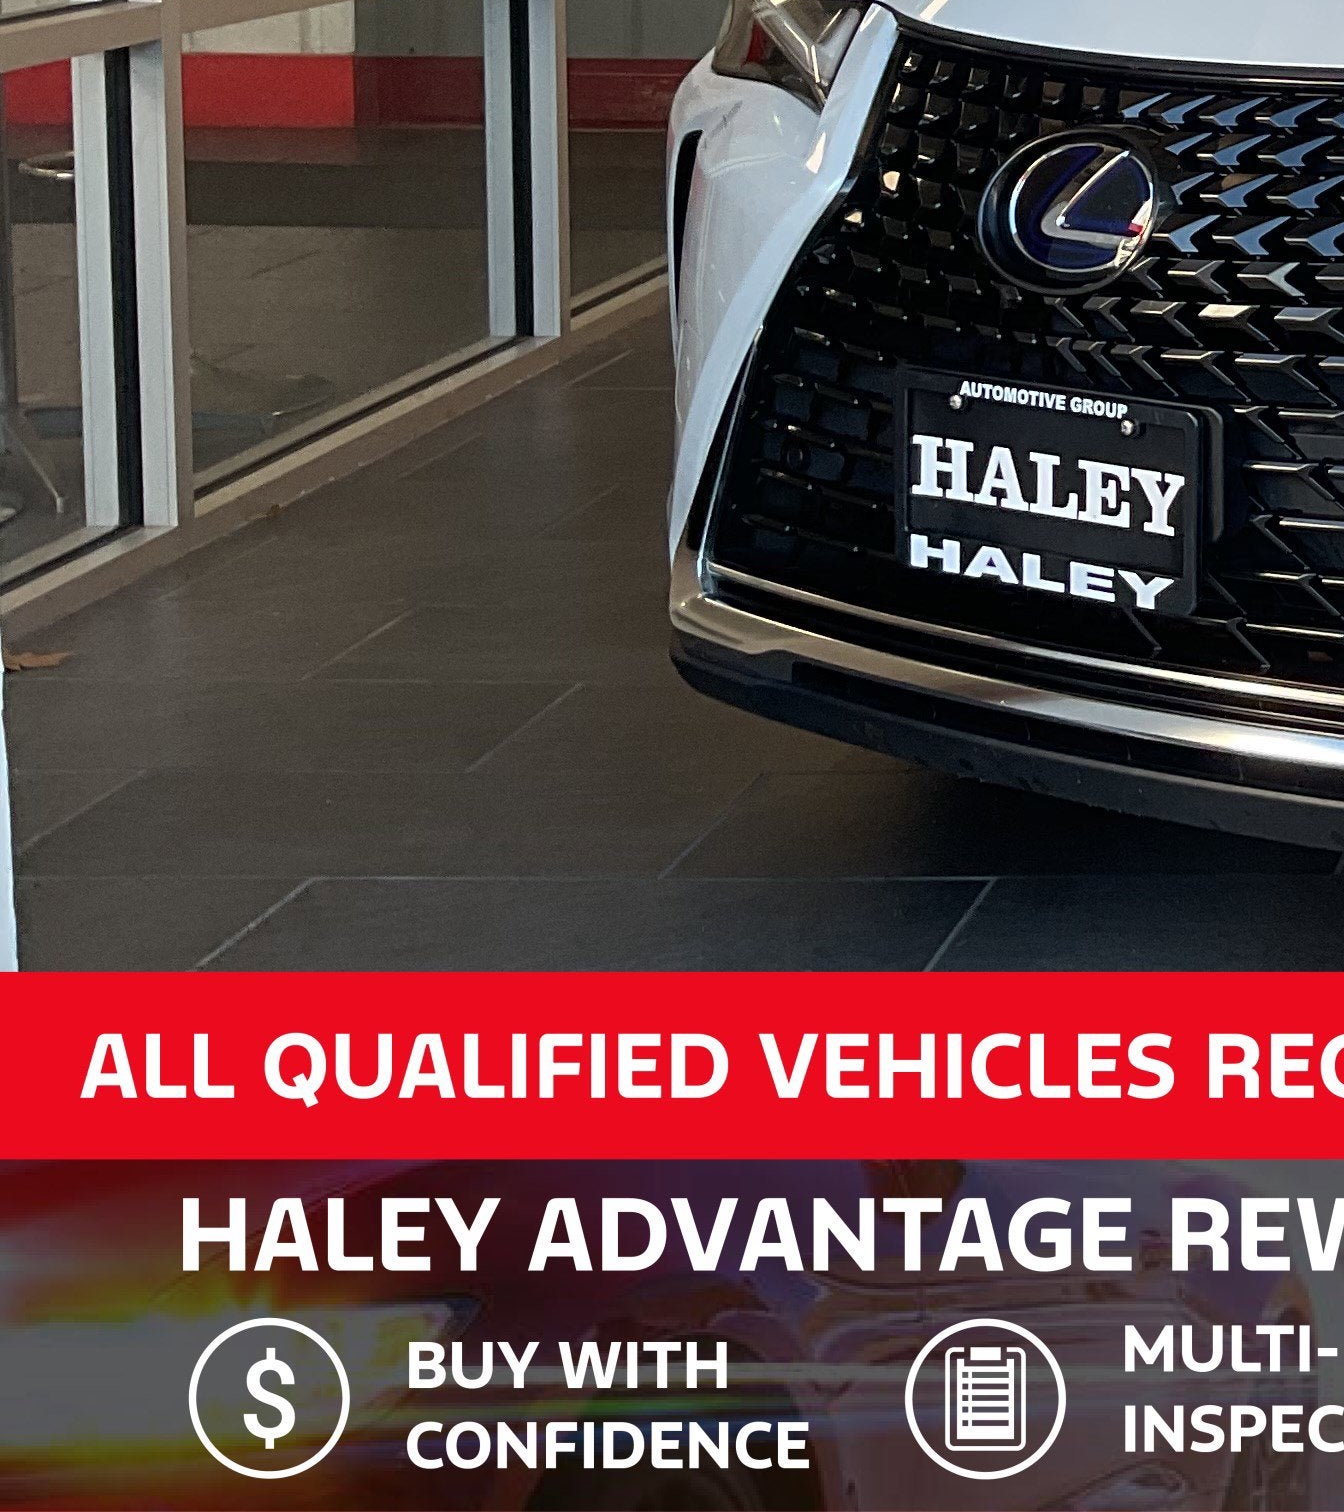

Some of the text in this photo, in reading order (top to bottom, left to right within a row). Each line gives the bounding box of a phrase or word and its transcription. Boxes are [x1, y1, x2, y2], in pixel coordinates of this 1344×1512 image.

[960, 381, 1129, 420] AUTOMOTIVE GROUP
[911, 434, 1185, 537] HALEY
[910, 533, 1175, 610] HALEY
